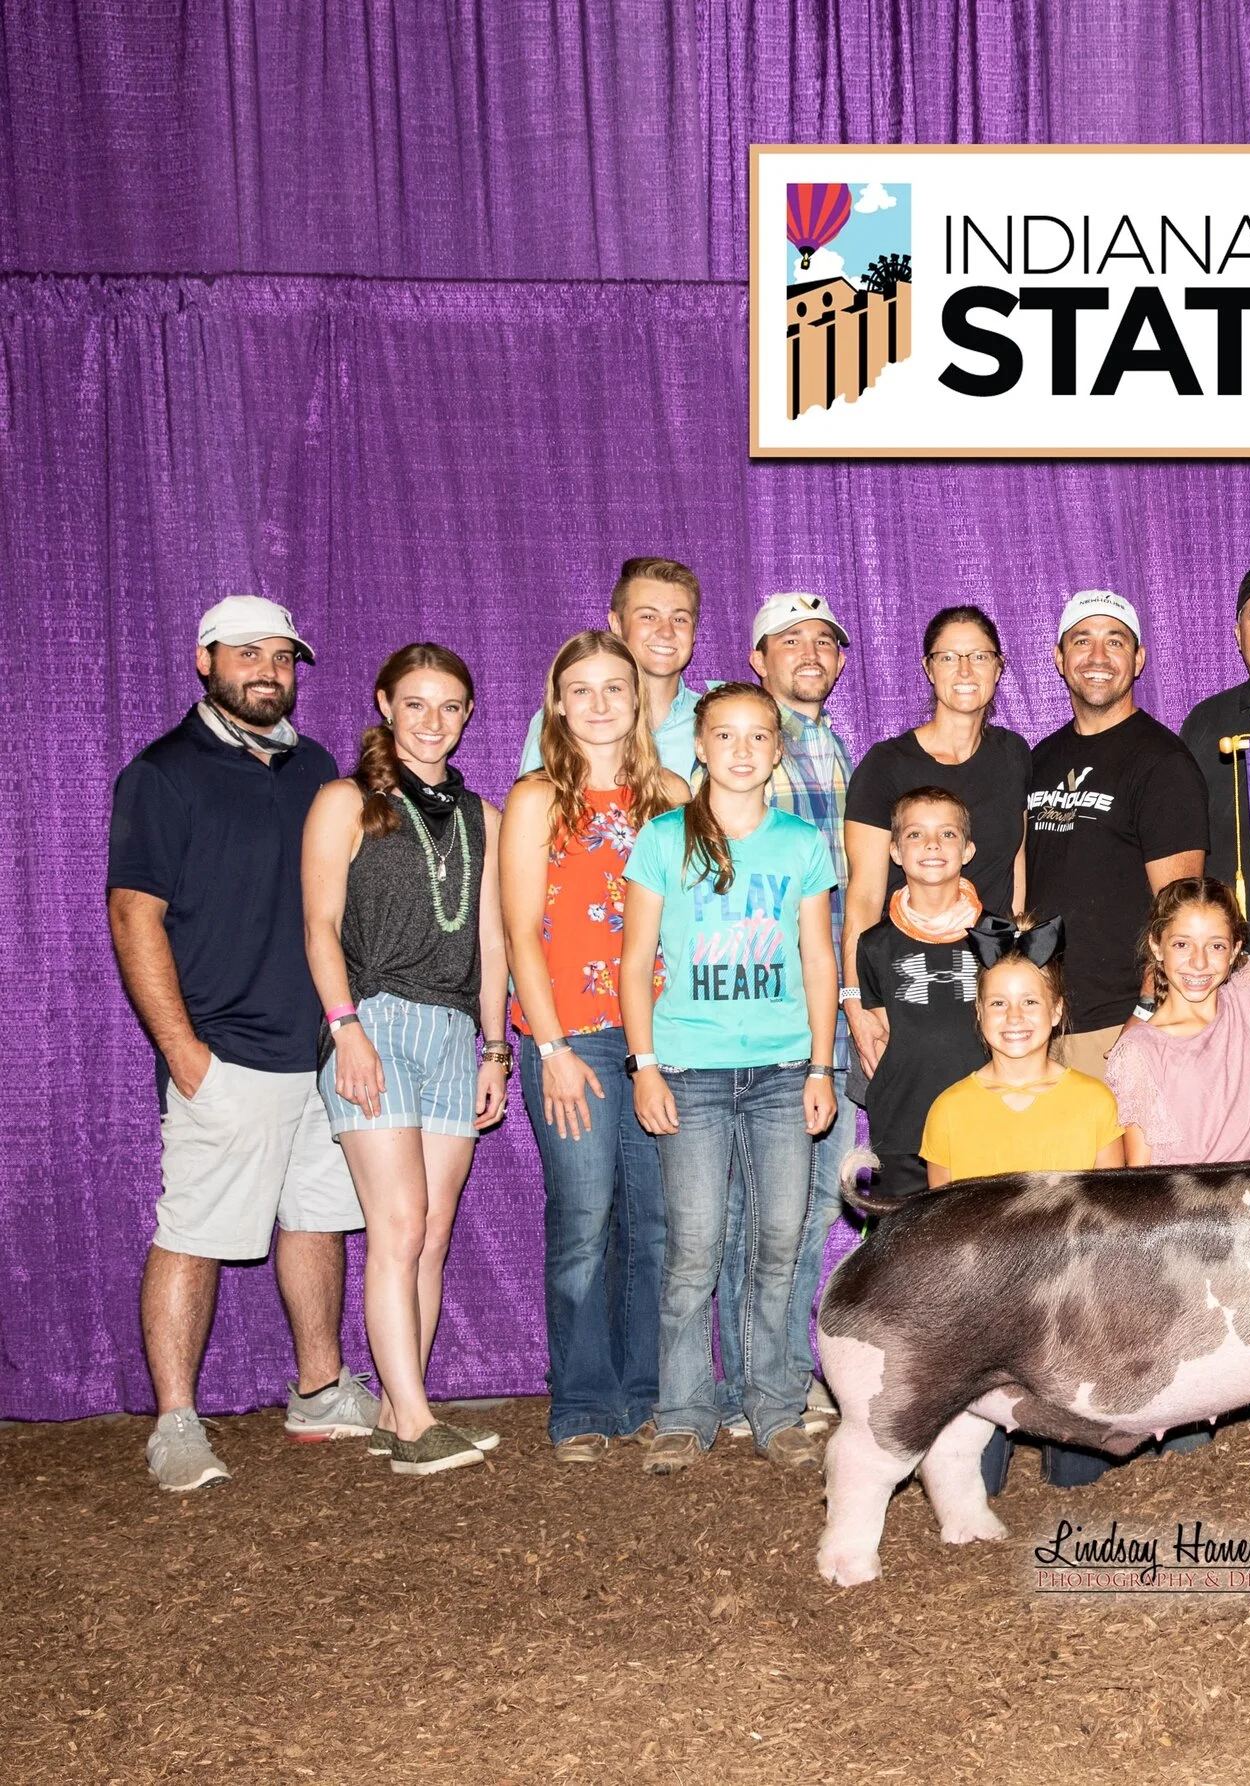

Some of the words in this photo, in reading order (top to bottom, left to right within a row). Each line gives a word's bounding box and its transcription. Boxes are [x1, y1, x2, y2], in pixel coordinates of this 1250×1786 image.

[1027, 791, 1115, 812] NEWHOUSE
[692, 873, 792, 922] PLAY
[692, 963, 784, 1001] HEART
